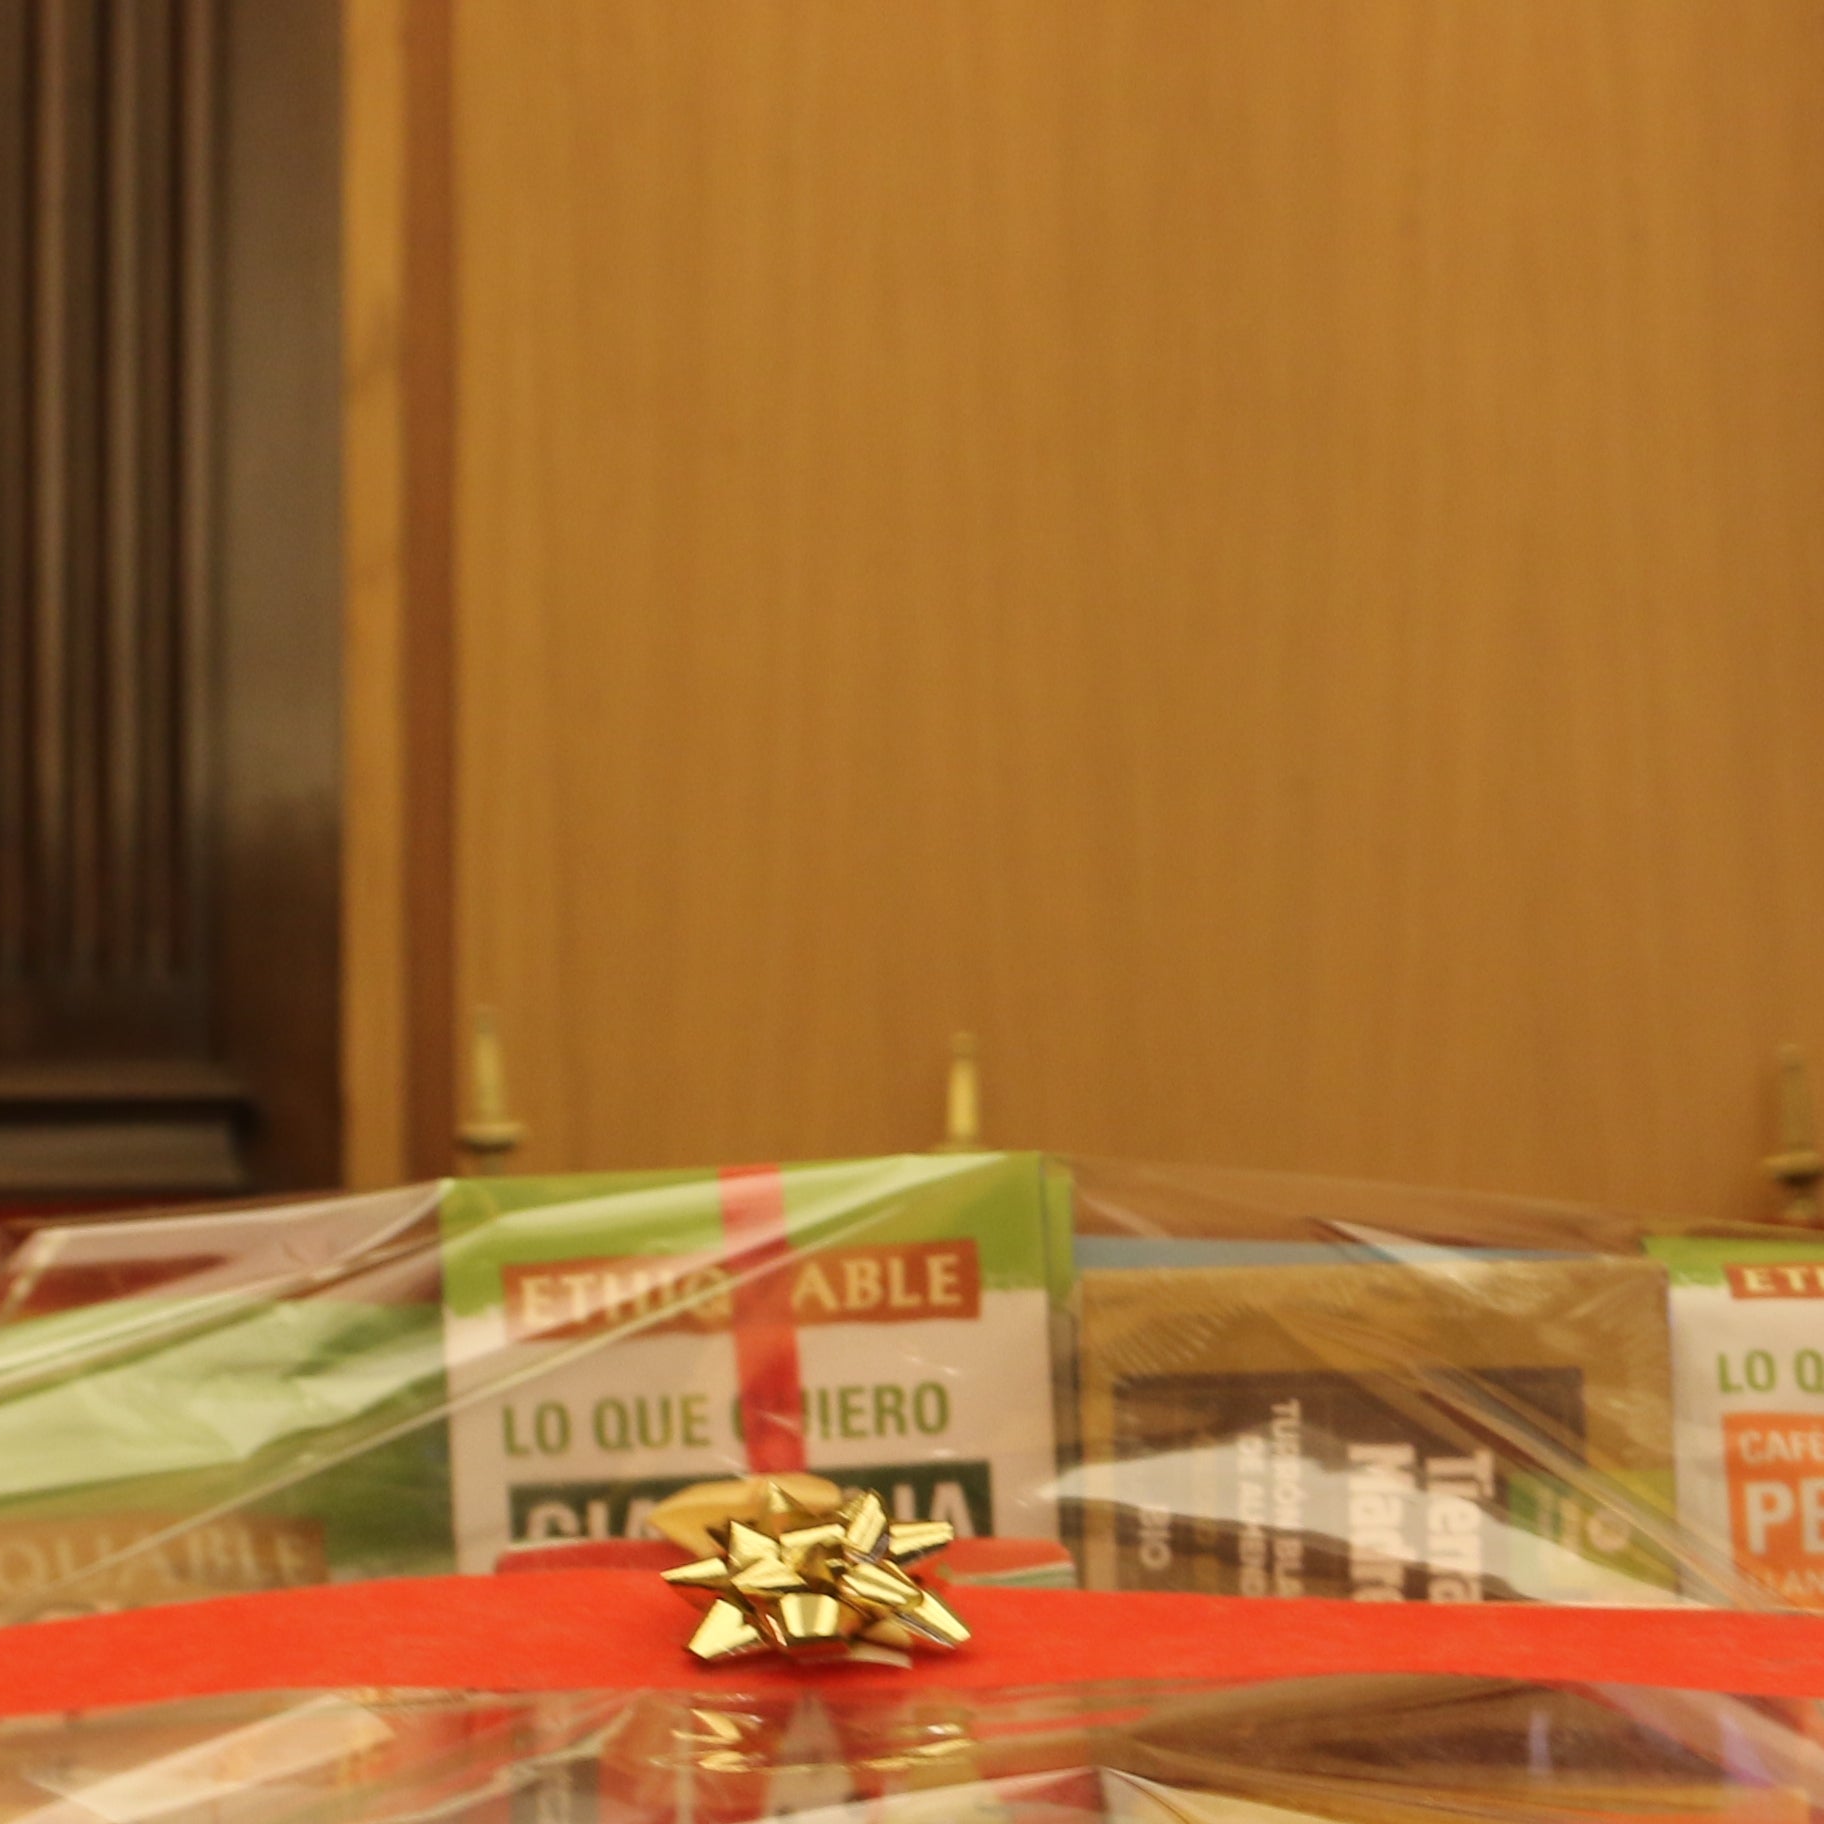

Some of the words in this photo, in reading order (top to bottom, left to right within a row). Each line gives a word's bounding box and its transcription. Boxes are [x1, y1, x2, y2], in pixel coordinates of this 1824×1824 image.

[518, 1252, 963, 1328] ETHIQABLE
[1717, 1351, 1775, 1394] LO
[502, 1402, 572, 1456] LO
[592, 1396, 712, 1450] QUE
[731, 1380, 950, 1442] IERO
